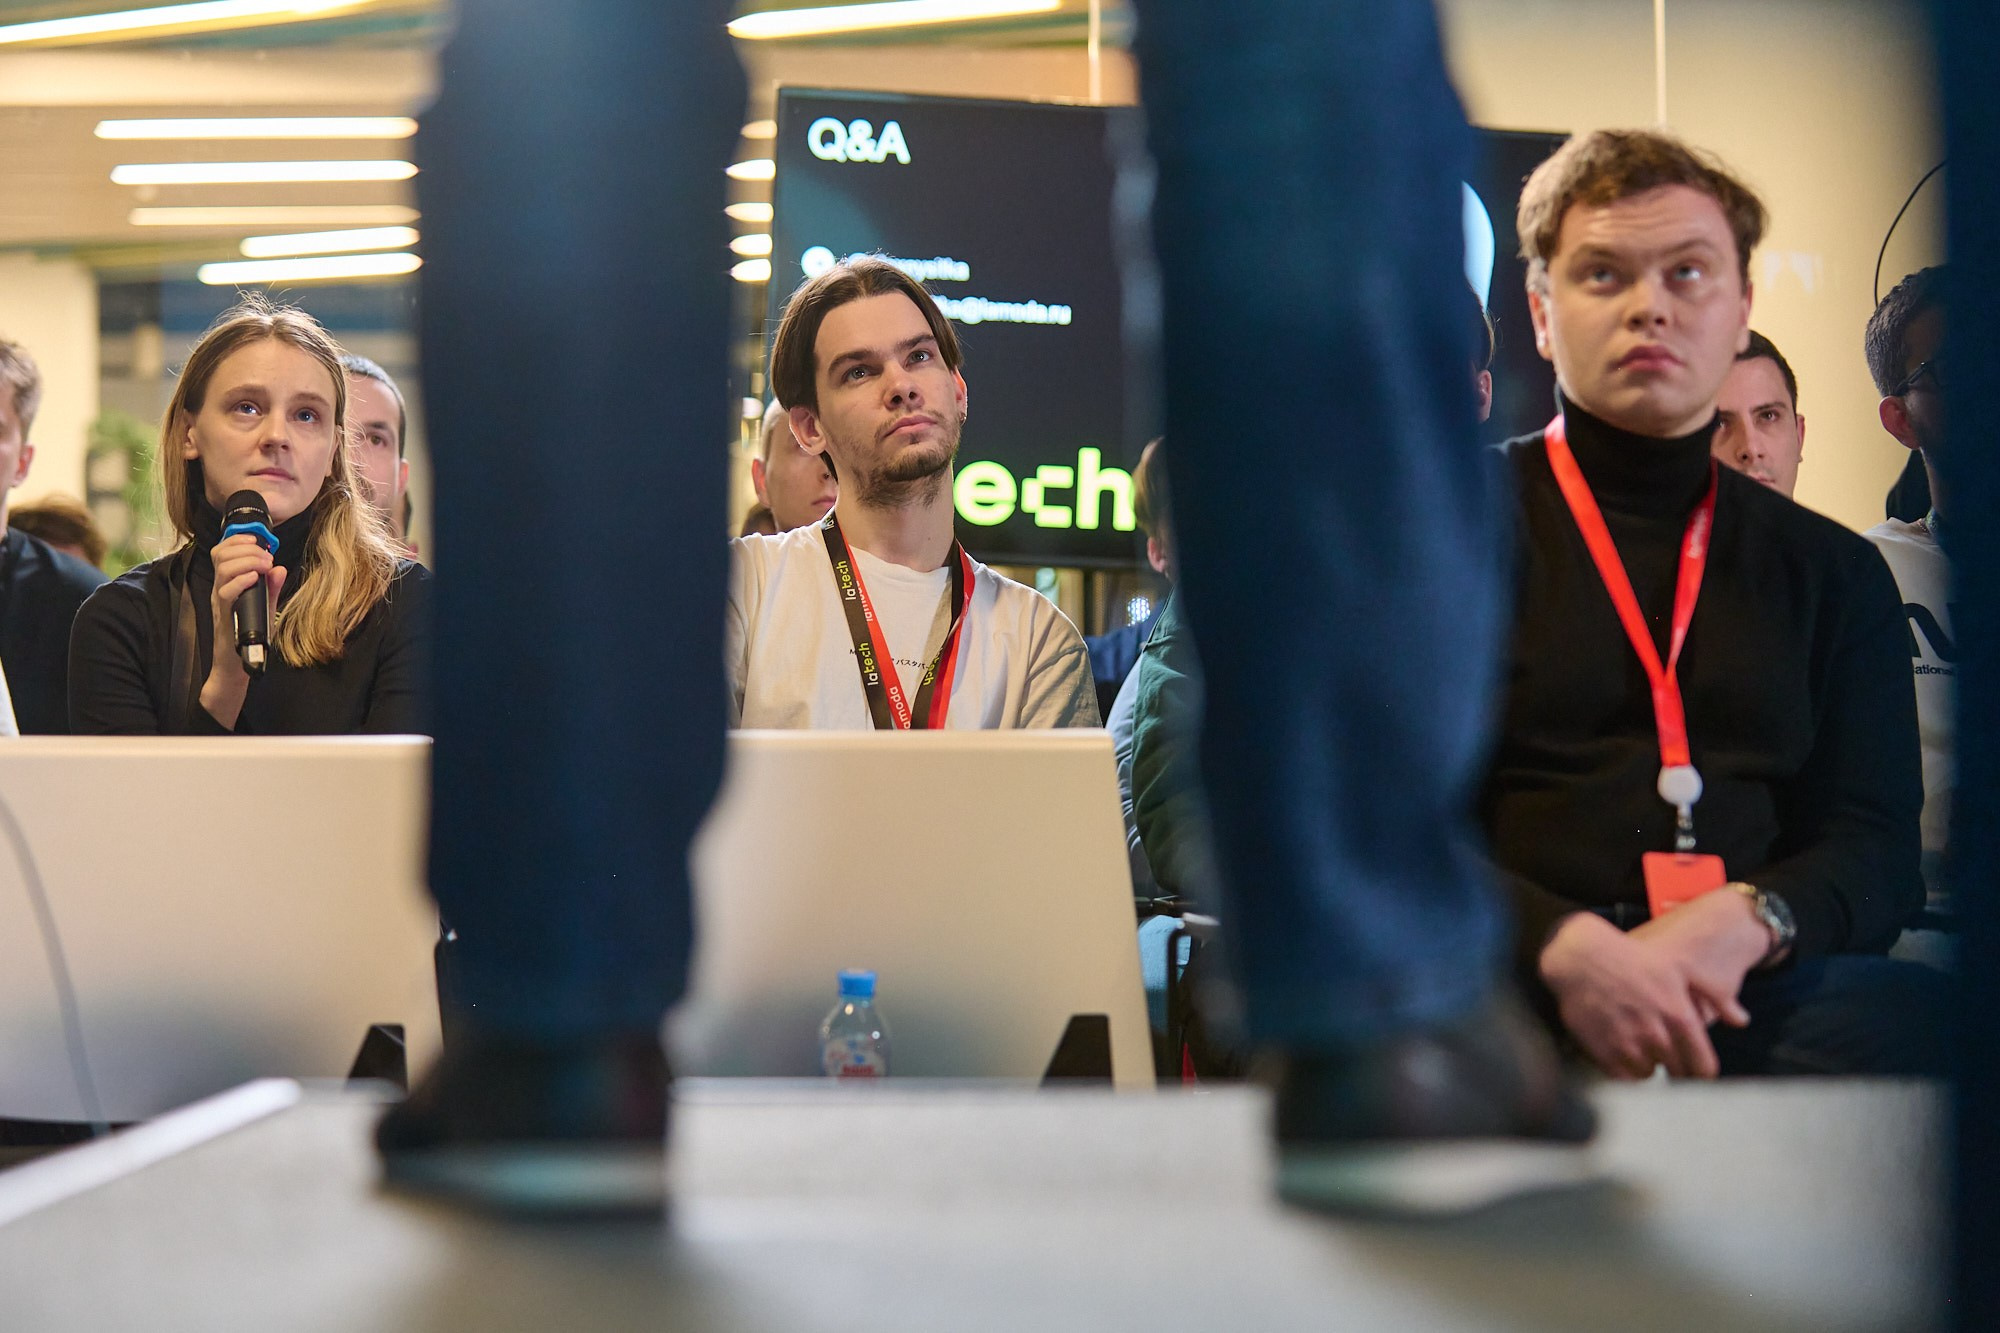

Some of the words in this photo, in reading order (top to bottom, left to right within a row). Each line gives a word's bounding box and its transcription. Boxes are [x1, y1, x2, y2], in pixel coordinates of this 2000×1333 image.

[806, 116, 912, 164] Q&A
[952, 446, 1137, 532] ech
[836, 560, 857, 601] latech
[858, 642, 879, 686] latech
[889, 686, 911, 730] amoda
